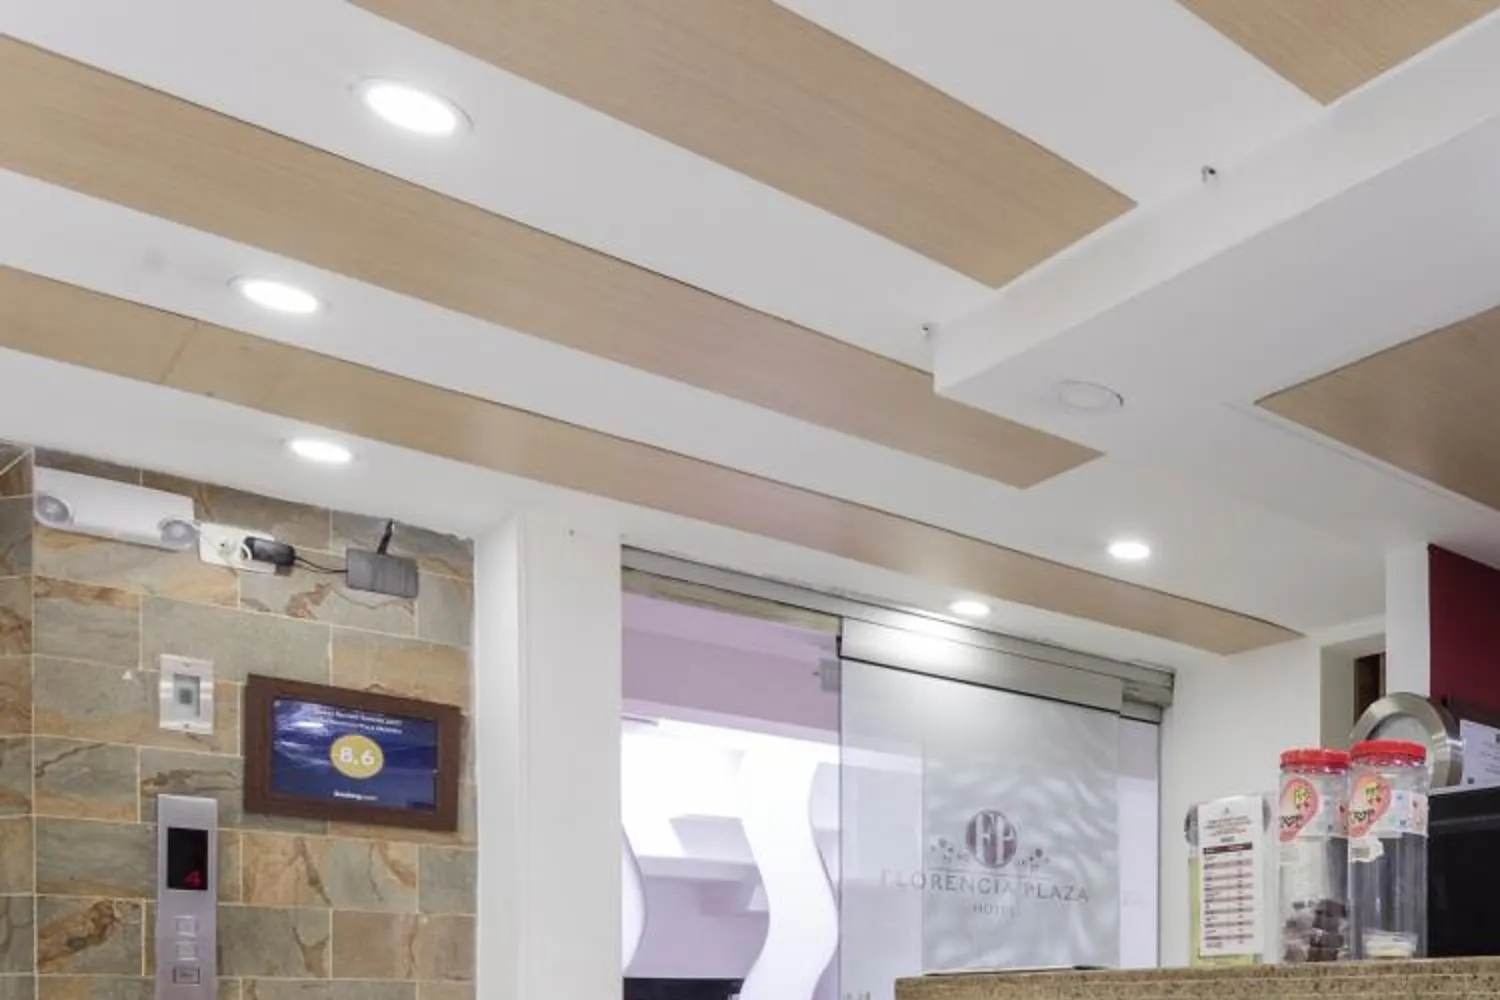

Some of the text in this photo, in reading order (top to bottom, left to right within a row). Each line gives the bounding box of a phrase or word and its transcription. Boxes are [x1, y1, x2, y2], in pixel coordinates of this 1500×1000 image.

[339, 747, 375, 767] 8.6
[880, 869, 1089, 903] FLORENCIA PLAZA
